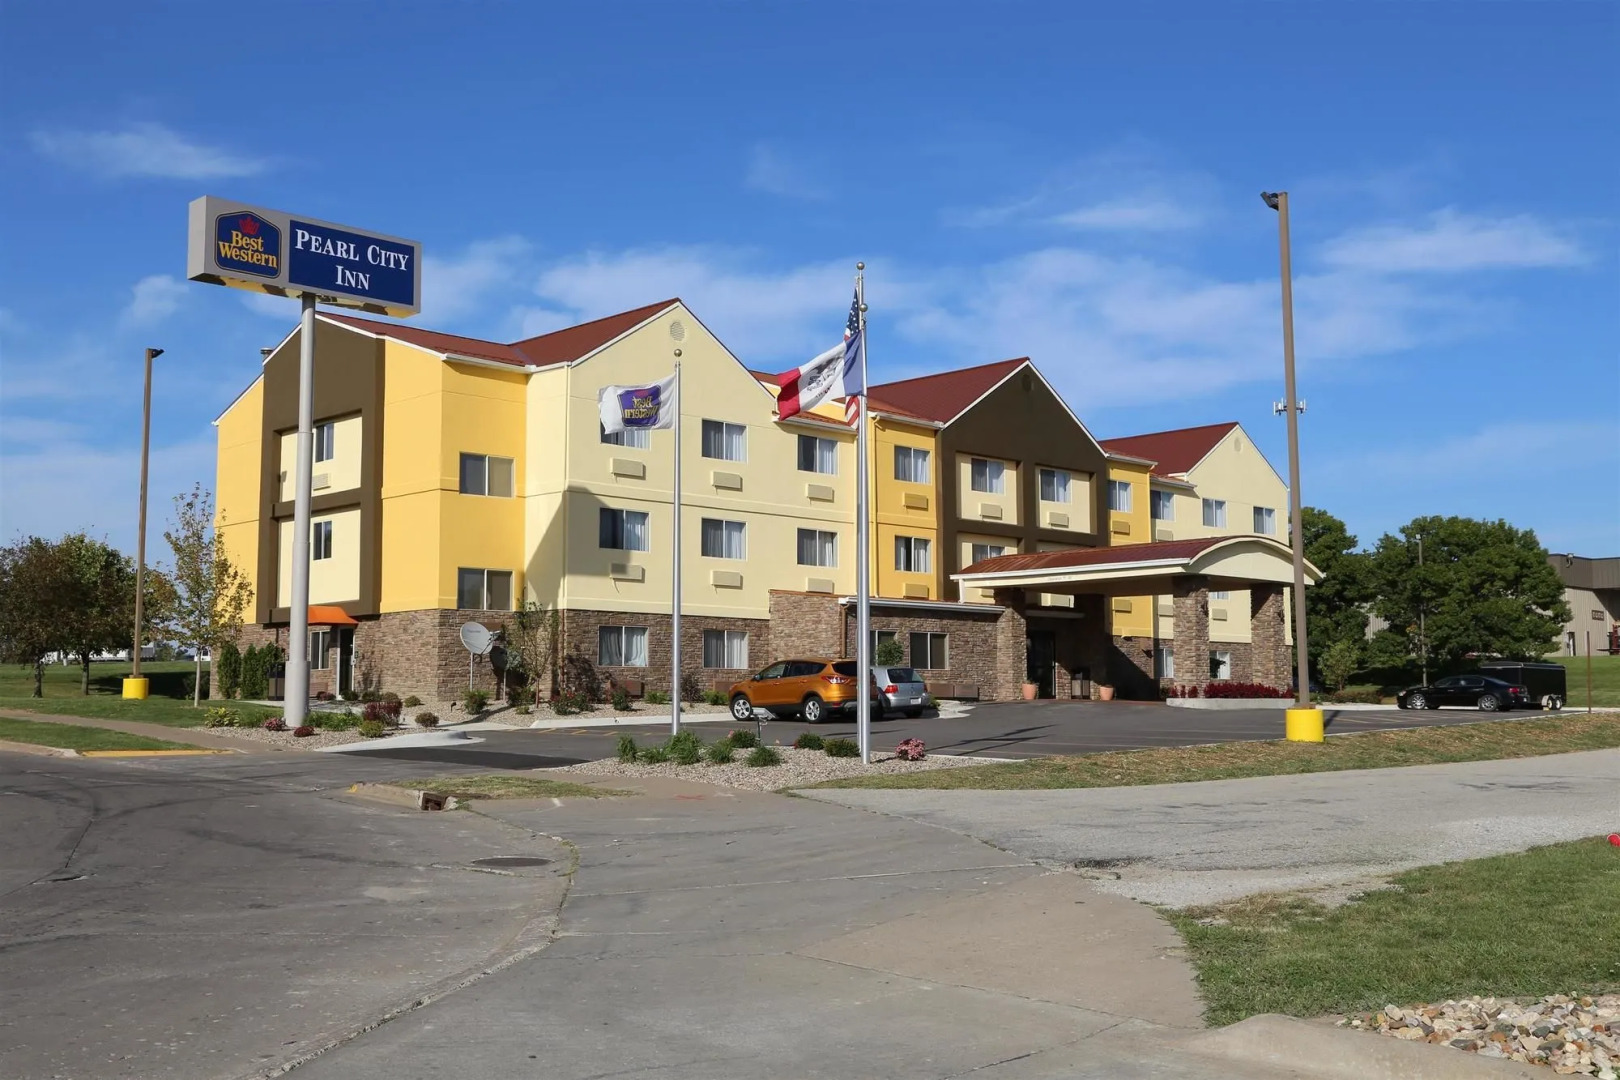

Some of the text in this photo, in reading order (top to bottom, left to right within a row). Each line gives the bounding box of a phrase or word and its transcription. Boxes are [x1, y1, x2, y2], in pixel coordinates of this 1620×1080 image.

[231, 230, 264, 251] Best
[295, 229, 408, 271] PEARL CITY
[218, 241, 277, 268] Western
[335, 265, 370, 290] INN
